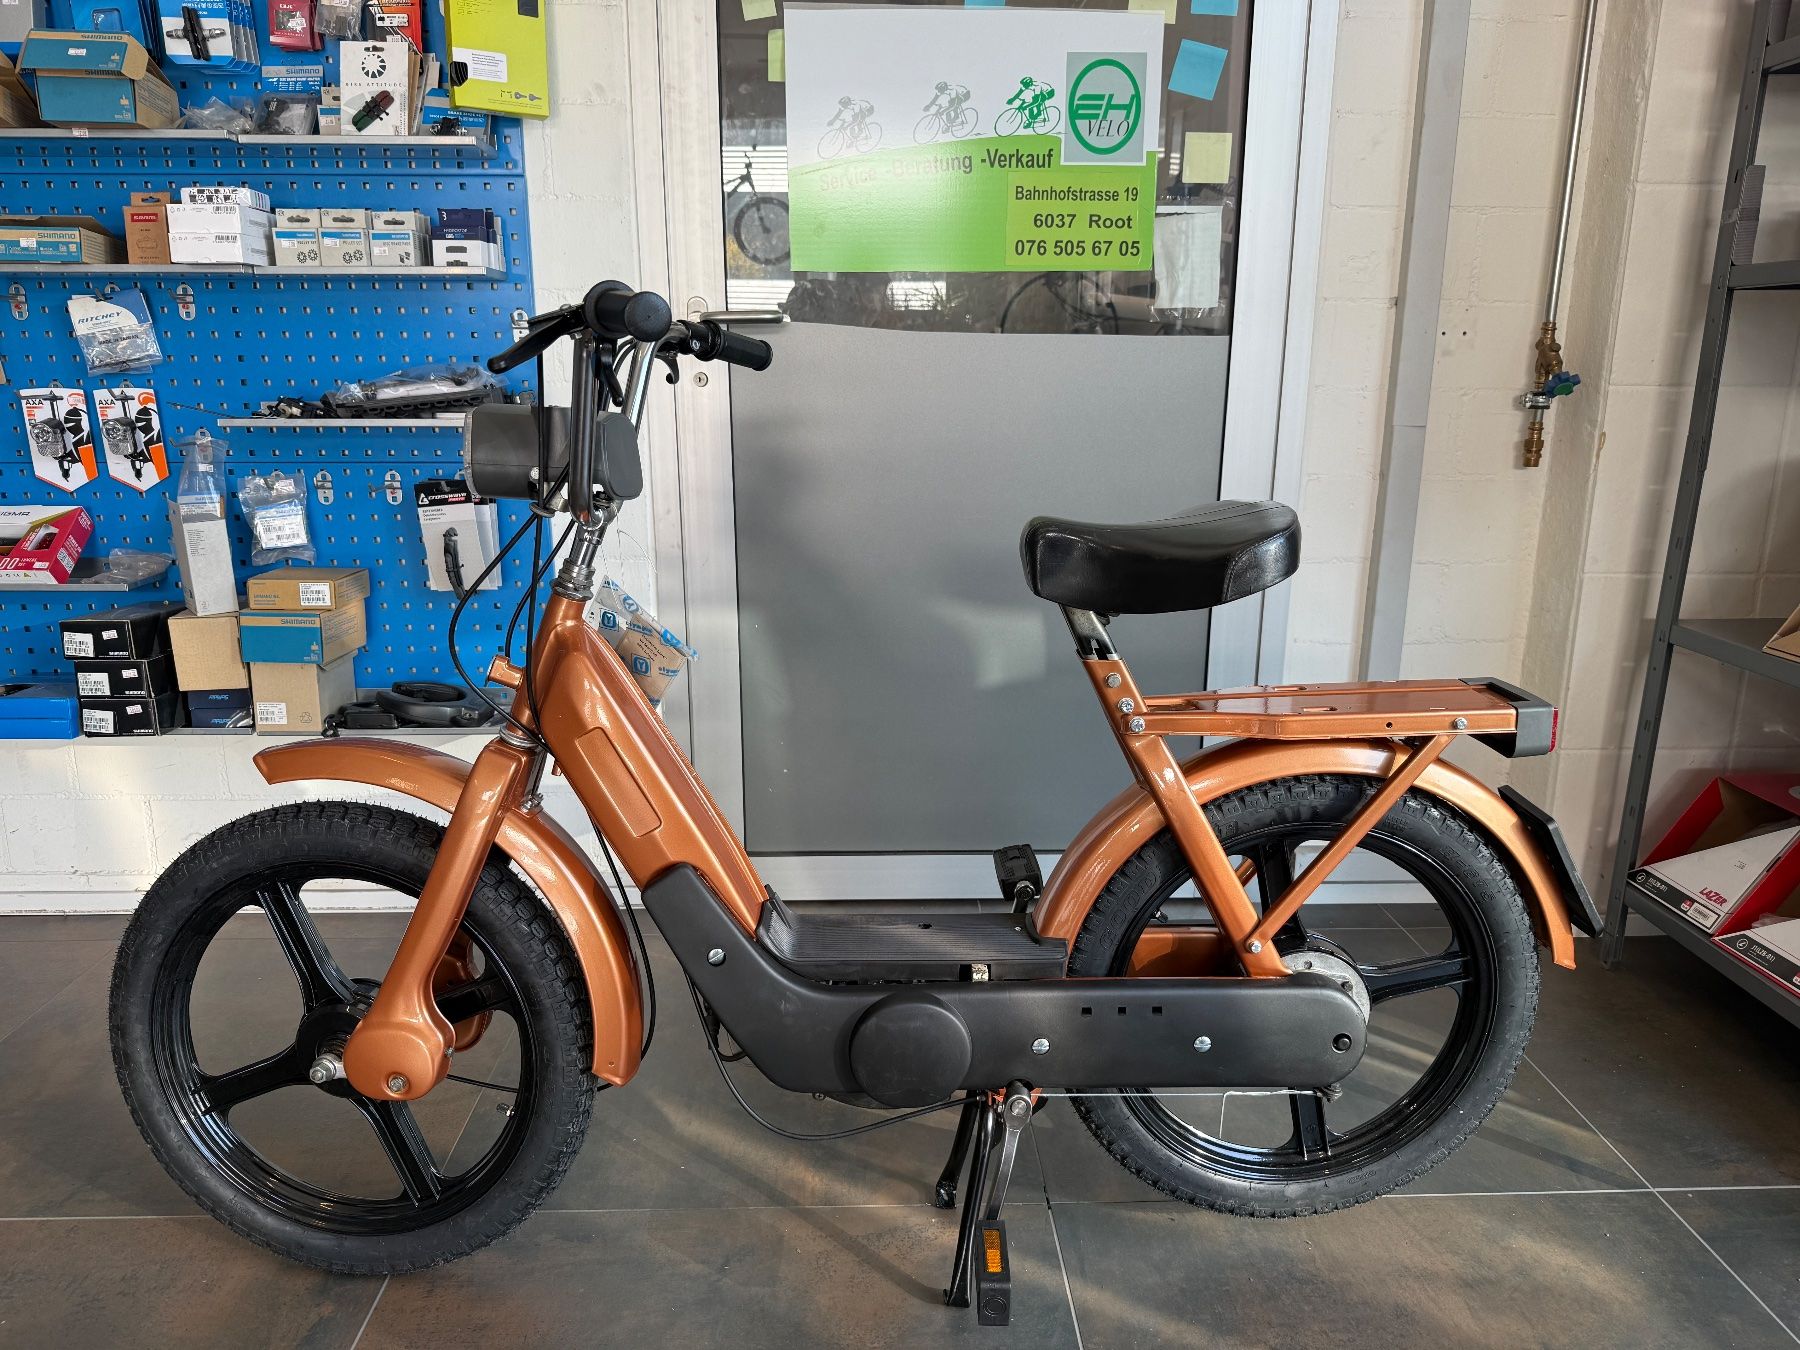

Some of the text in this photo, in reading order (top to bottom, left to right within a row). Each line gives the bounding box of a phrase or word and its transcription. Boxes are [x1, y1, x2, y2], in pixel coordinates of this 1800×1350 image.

[1087, 119, 1130, 137] VELO
[980, 148, 1054, 169] -Verkauf
[1015, 185, 1139, 202] Bahnhofstrasse 19
[1033, 213, 1133, 229] 6037 Root
[37, 232, 76, 240] SHIMANO
[1015, 239, 1141, 257] 076 505 67 05
[77, 310, 123, 325] RITCHEY
[1699, 886, 1728, 907] LAZER
